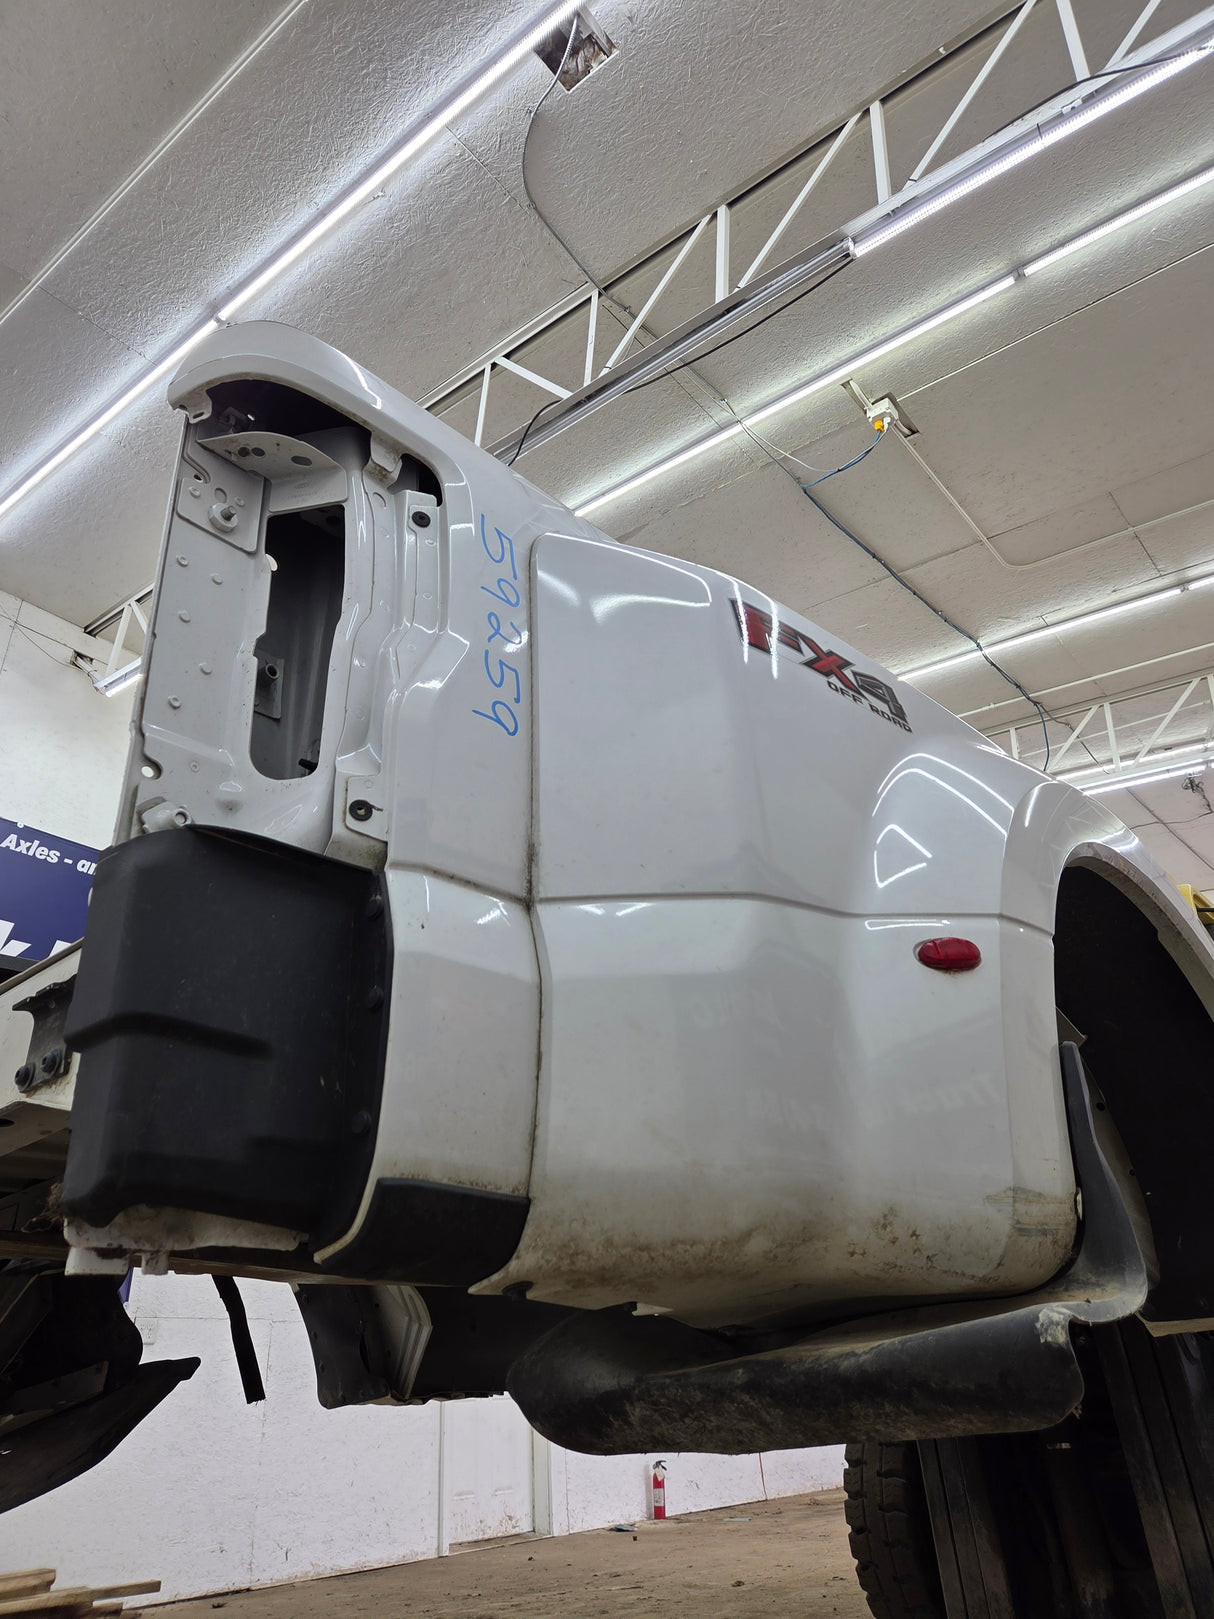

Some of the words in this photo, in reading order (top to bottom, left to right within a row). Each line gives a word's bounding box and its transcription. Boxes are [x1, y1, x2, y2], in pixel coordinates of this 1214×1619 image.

[472, 513, 522, 737] 59259
[729, 598, 909, 724] FX4
[827, 680, 865, 705] OFF
[868, 703, 913, 734] ROAD
[0, 833, 61, 863] Axles
